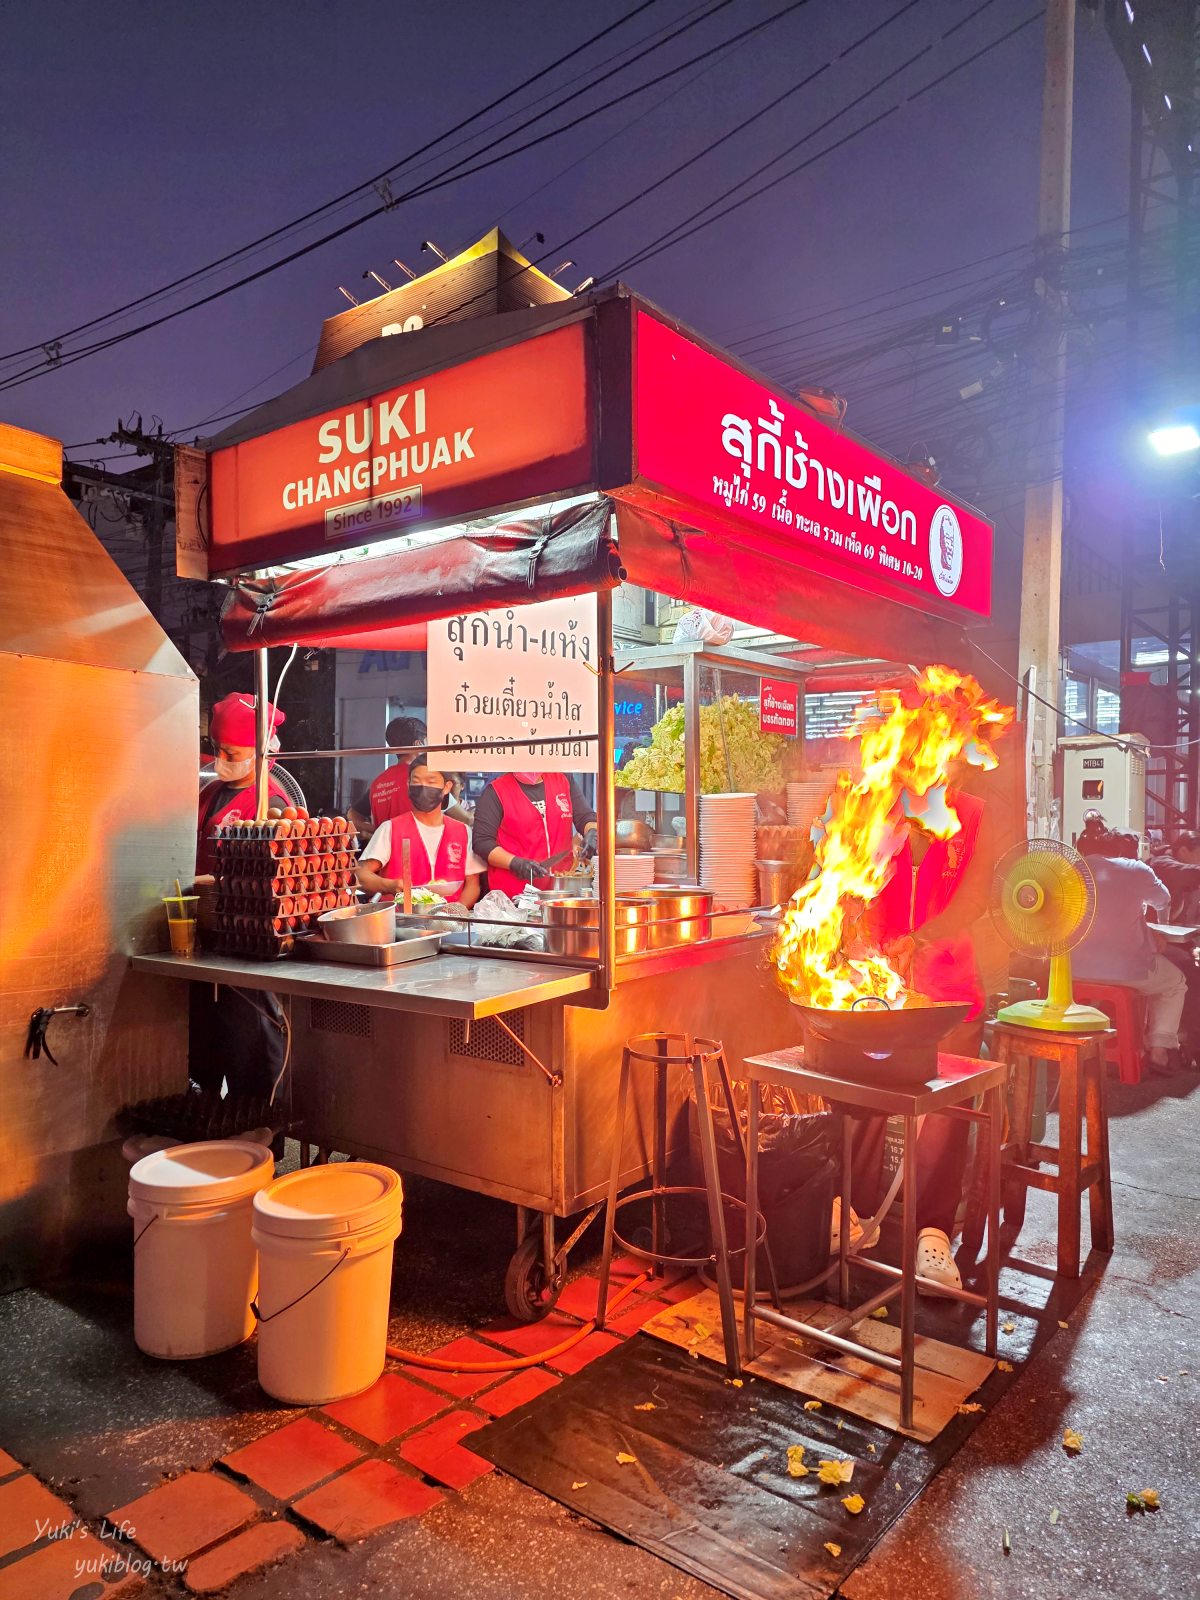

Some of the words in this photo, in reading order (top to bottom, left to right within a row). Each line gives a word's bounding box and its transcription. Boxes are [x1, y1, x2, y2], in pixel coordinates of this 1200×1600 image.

[318, 388, 426, 464] SUKI
[282, 427, 475, 510] CHANGPHUAK
[721, 399, 917, 546] สุกี้ช้างเผือก
[333, 511, 372, 530] Since
[377, 495, 412, 520] 1992
[752, 493, 766, 513] 59
[772, 489, 793, 525] เนื้อ
[796, 514, 821, 538] ทะเล
[823, 526, 843, 547] รวม
[863, 544, 875, 560] 69
[879, 545, 901, 571] พิเศษ
[902, 561, 923, 580] 10-20
[455, 676, 582, 721] ก๋วยเตี๋ยวน้ำใส
